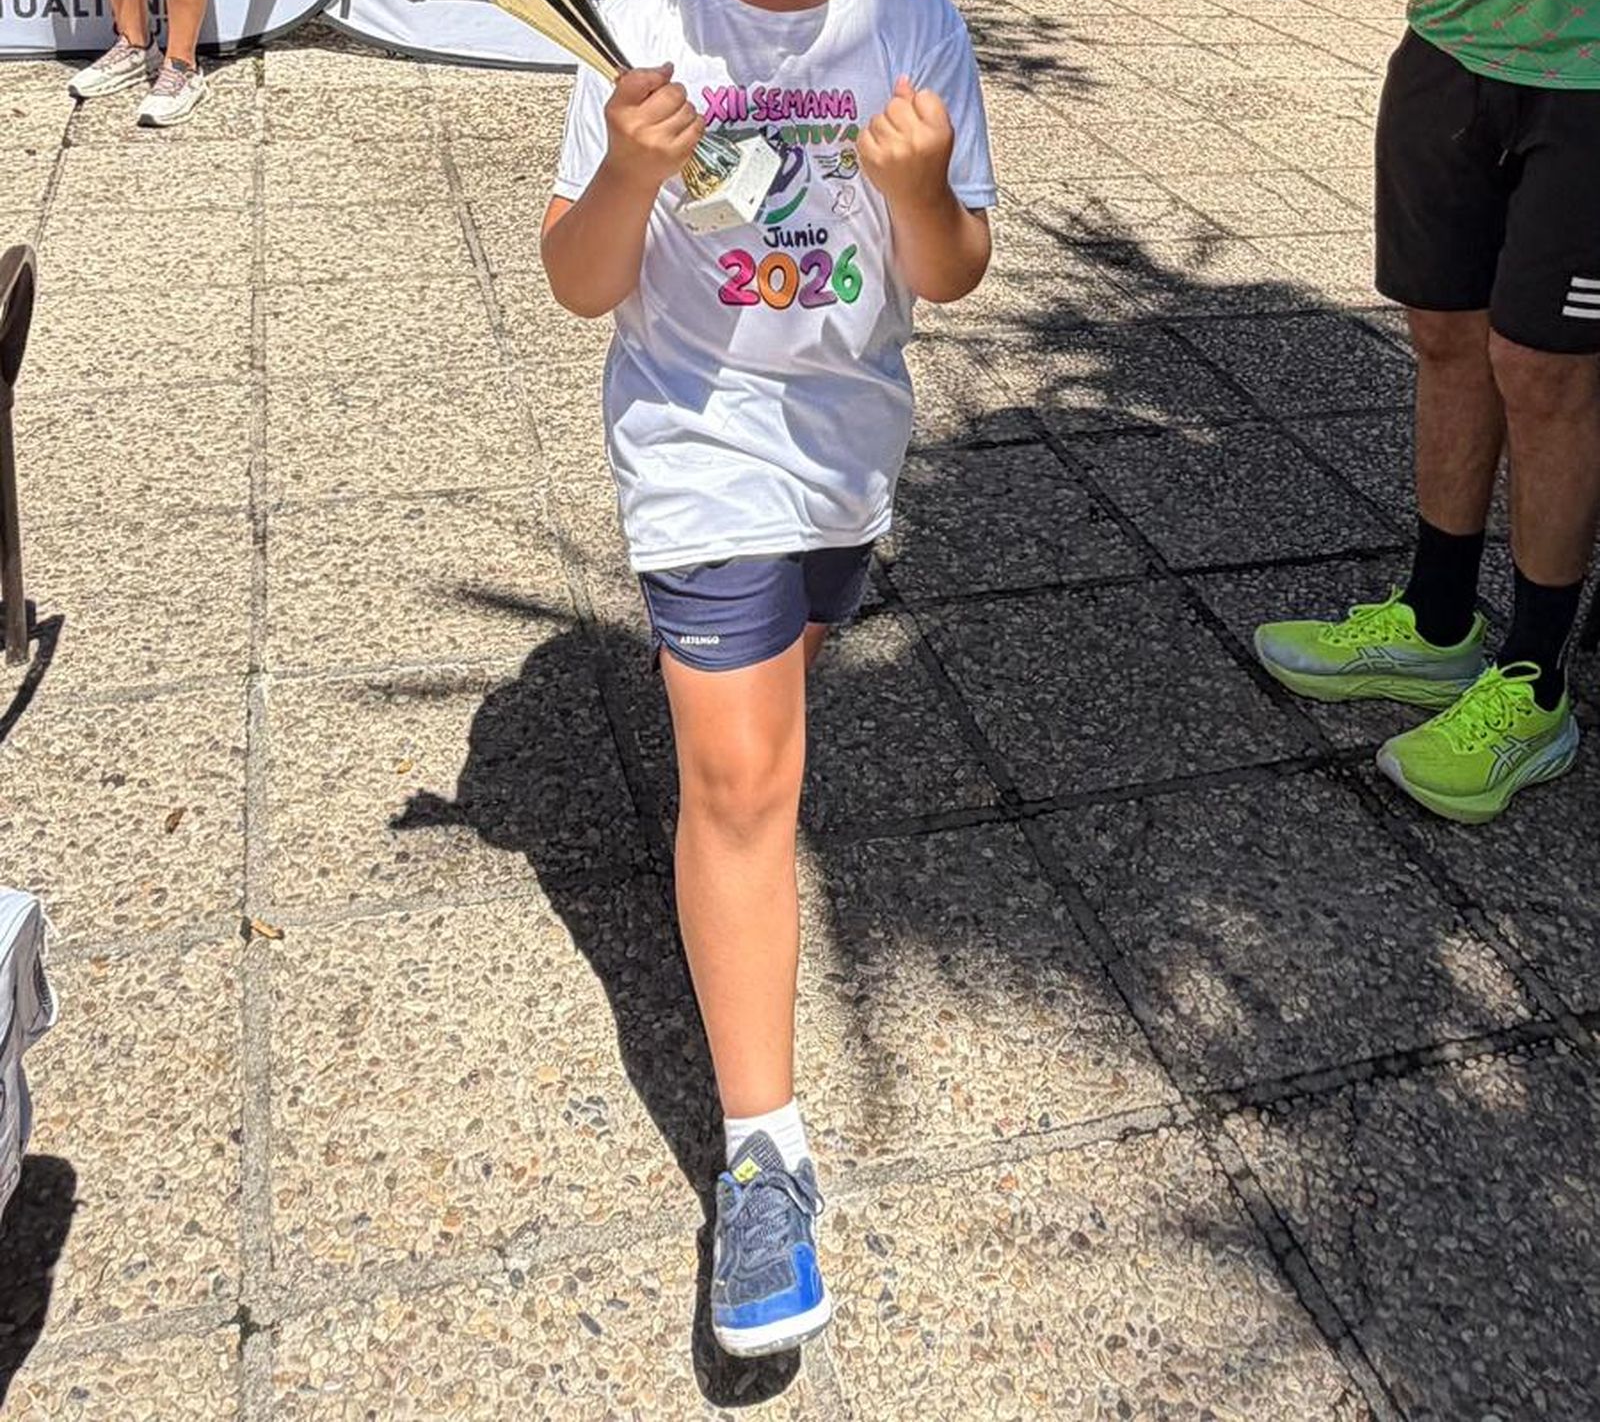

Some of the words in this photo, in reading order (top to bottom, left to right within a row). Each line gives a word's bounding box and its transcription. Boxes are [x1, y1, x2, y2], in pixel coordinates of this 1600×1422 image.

[702, 85, 748, 126] XII
[752, 86, 858, 122] SEMANA
[763, 224, 828, 247] Junio
[717, 243, 863, 310] 2026
